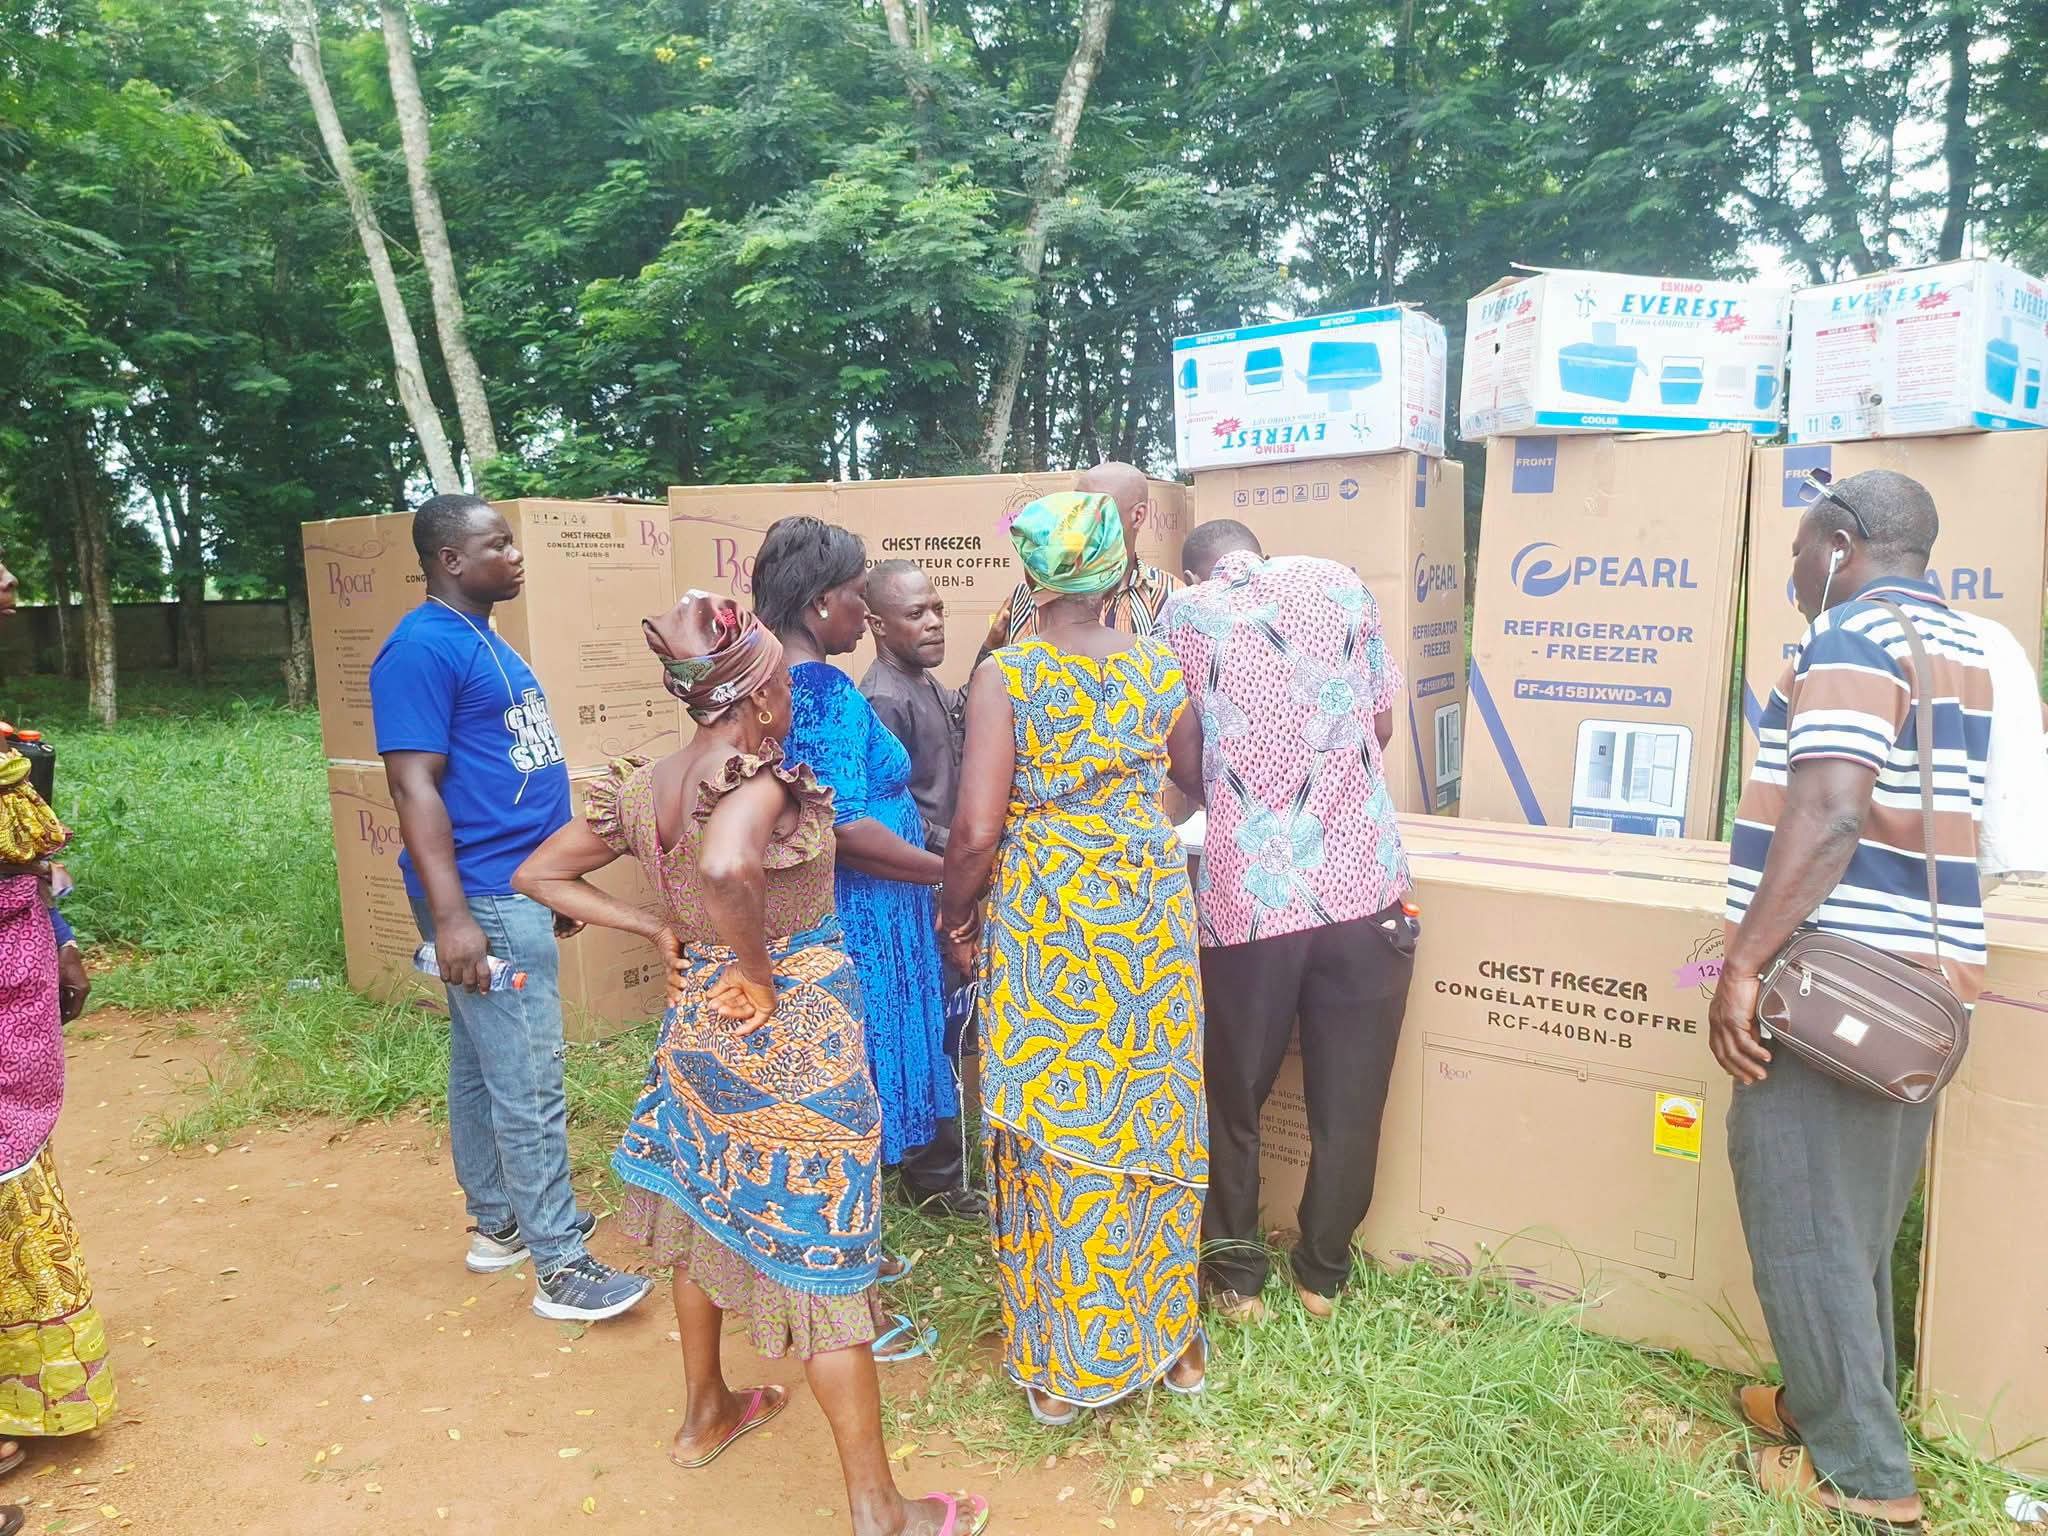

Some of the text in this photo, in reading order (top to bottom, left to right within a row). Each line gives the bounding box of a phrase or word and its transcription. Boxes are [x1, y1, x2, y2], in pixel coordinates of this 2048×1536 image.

[1660, 281, 1704, 294] ESKIMO
[1832, 282, 1940, 311] EVEREST
[1621, 294, 1737, 318] EVEREST
[1580, 415, 1619, 425] COOLER
[1222, 423, 1327, 449] EVEREST
[1255, 443, 1296, 454] ESKIMO
[1516, 457, 1554, 467] FRONT
[882, 536, 981, 551] CHEST FREEZER
[956, 557, 1010, 568] COFFRE
[1573, 556, 1698, 589] PEARL
[1429, 564, 1458, 590] PEARL
[1924, 567, 2004, 600] ARL
[1412, 620, 1458, 640] REFRIGERATOR
[1503, 619, 1693, 643] REFRIGERATOR
[1423, 641, 1451, 658] FREEZER
[1546, 643, 1658, 664] FREEZER
[1517, 683, 1667, 704] PF-415BIXWD-1A
[1478, 960, 1648, 1002] CHEST FREEZER
[1434, 980, 1697, 1035] CONGÉLATEUR COFFRE
[1487, 1011, 1633, 1049] RCF-440BN-B
[1265, 1124, 1286, 1136] VCM
